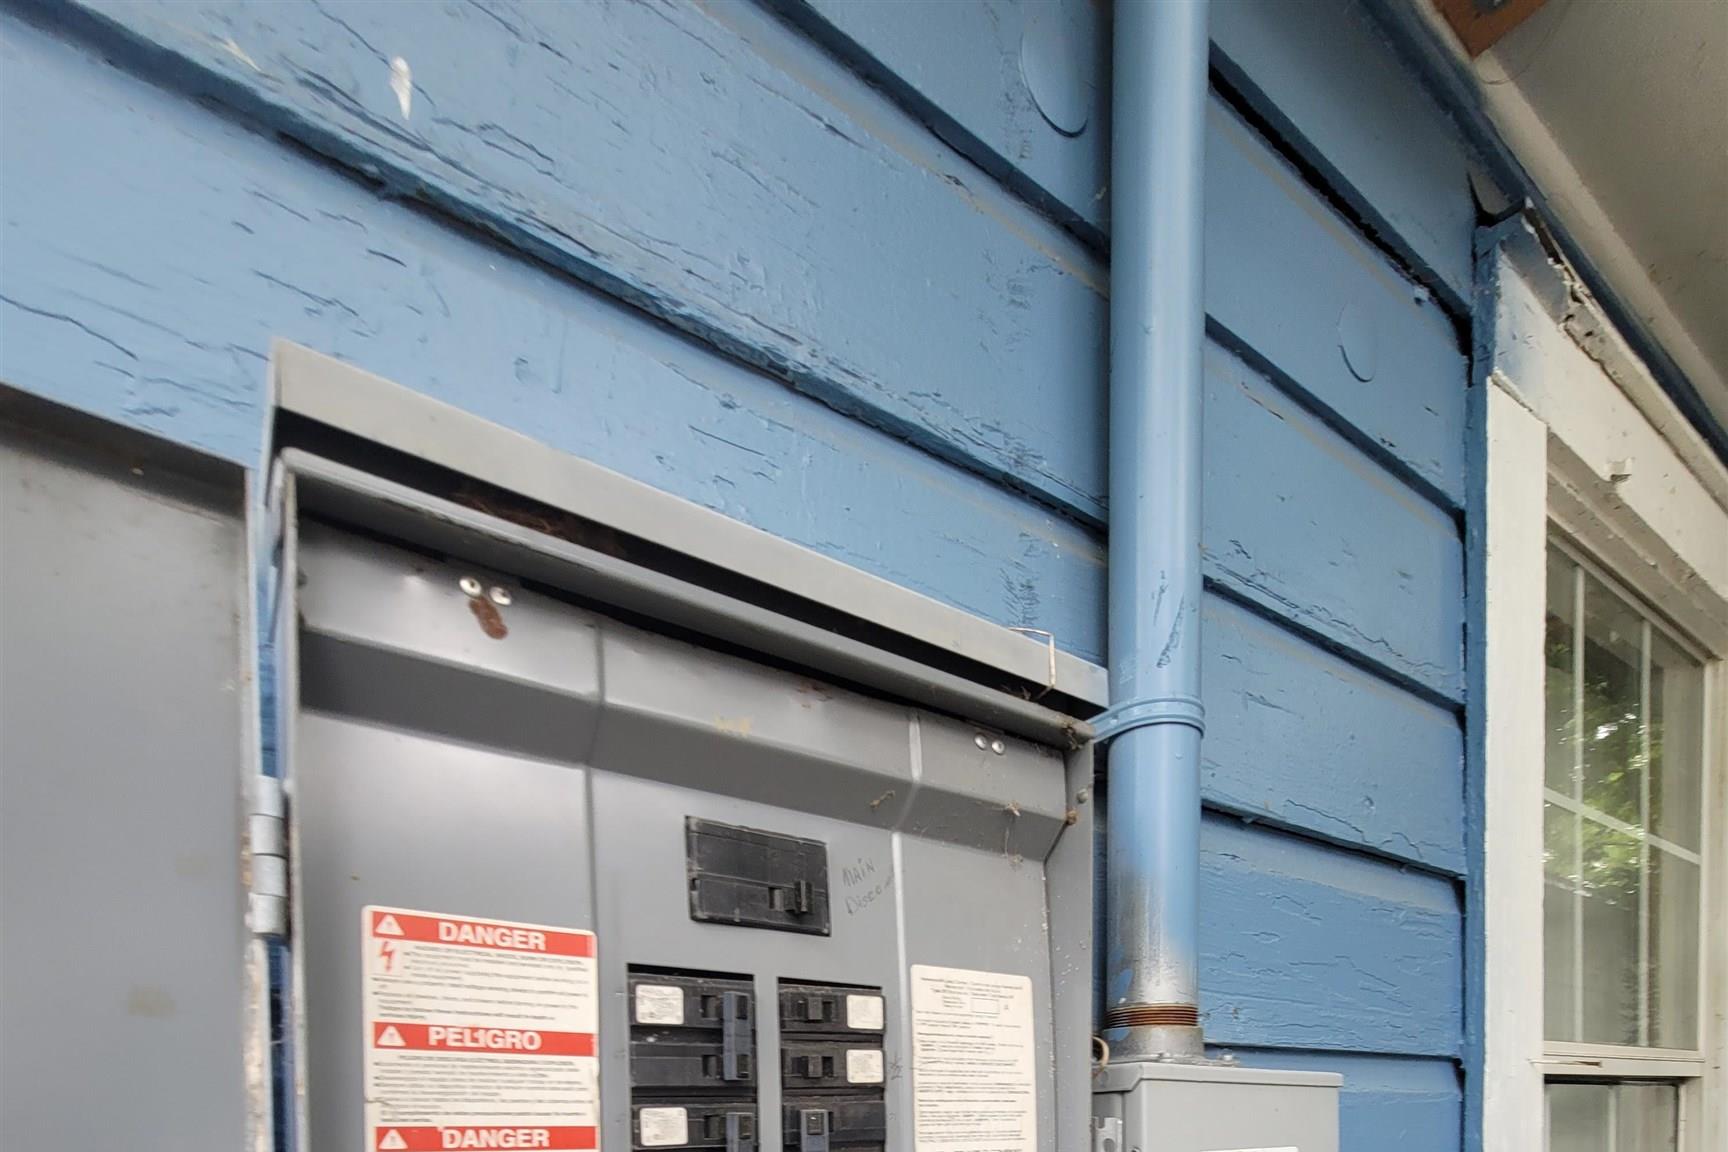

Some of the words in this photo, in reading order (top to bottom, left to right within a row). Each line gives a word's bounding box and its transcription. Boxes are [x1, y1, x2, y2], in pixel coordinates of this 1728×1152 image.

[438, 921, 547, 951] DANGER
[428, 1026, 542, 1050] PELIGRO
[441, 1128, 550, 1149] DANGER
